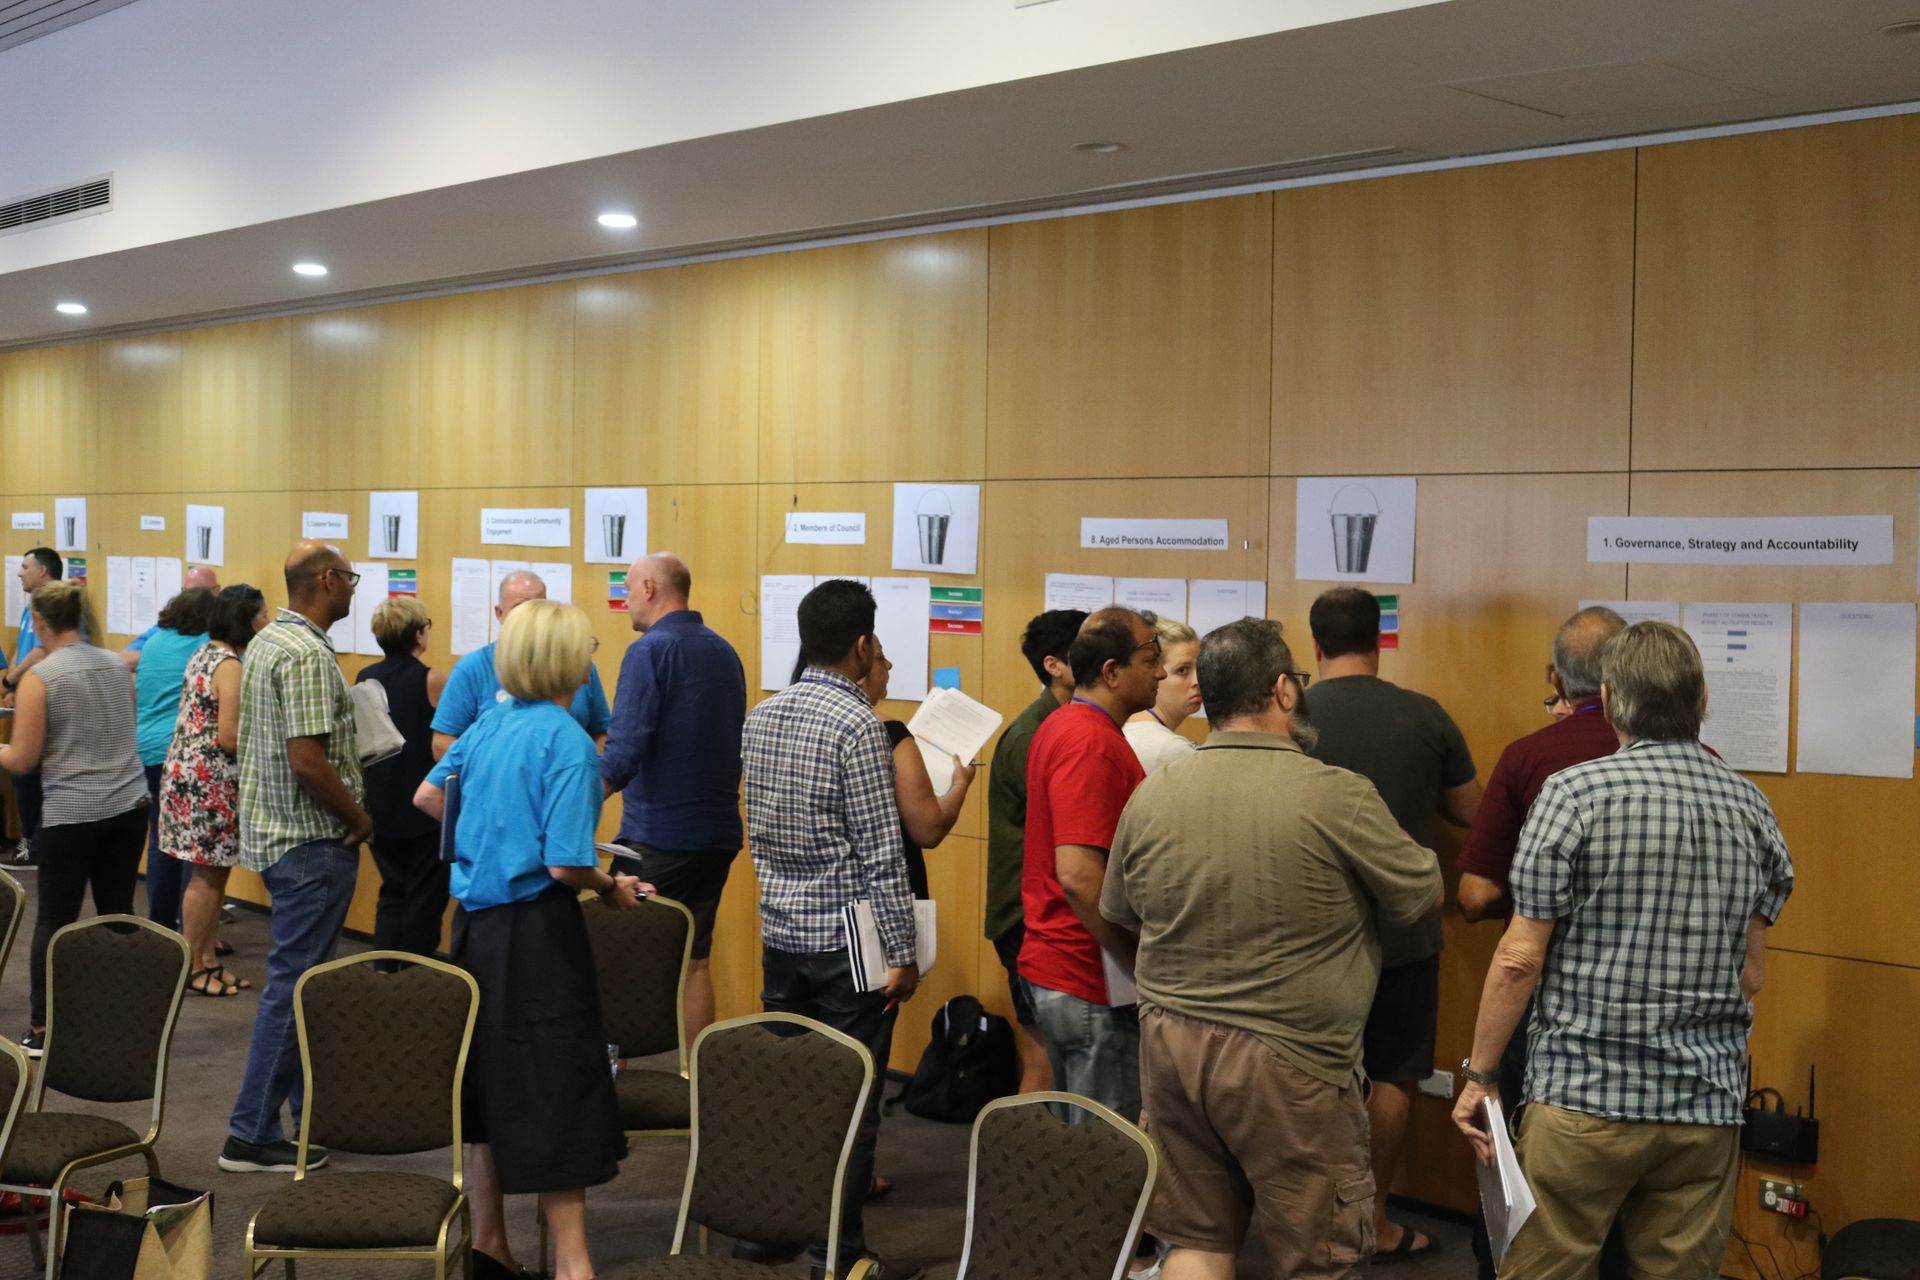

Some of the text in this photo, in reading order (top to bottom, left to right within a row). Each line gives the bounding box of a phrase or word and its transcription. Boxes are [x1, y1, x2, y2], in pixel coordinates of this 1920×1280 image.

[524, 516, 533, 525] and
[800, 523, 828, 532] Members
[829, 523, 836, 532] of
[836, 523, 861, 532] Council
[1100, 535, 1120, 547] Aged
[1121, 535, 1154, 545] Persons
[1156, 536, 1225, 547] Accommodation
[1603, 537, 1859, 552] 1. Governance, Strategy and Accountability
